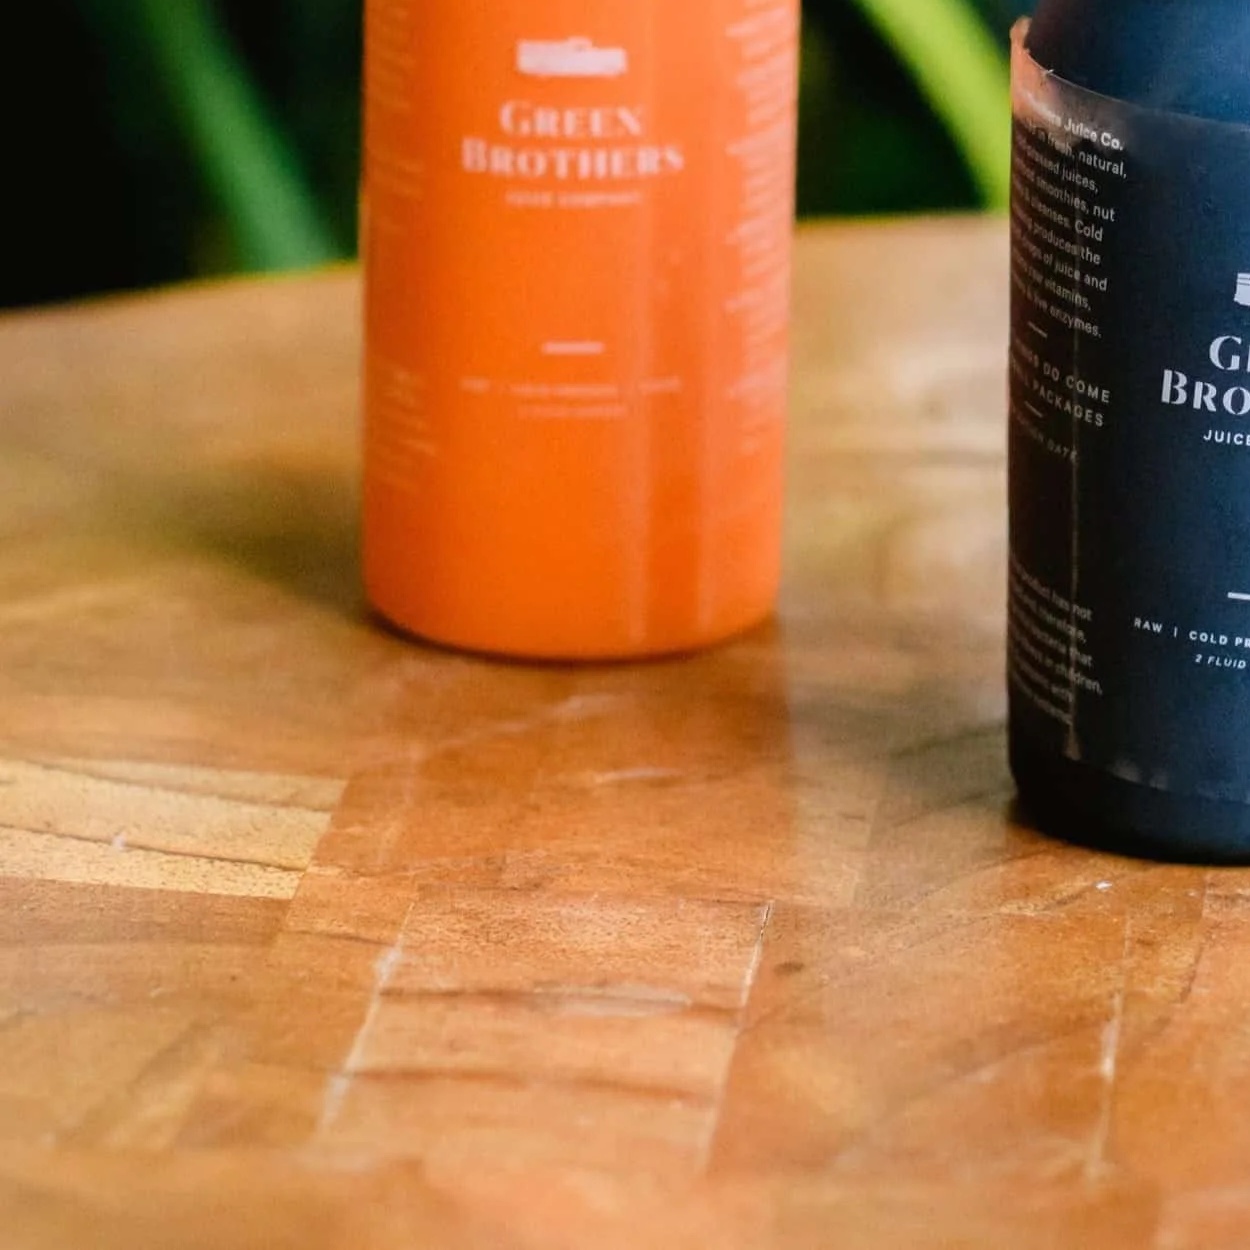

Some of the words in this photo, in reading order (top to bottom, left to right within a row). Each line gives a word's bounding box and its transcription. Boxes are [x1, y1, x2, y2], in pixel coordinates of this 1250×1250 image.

[1063, 117, 1098, 143] Juice
[1100, 131, 1124, 151] Co.
[461, 136, 686, 181] BROTHERS
[1078, 150, 1128, 180] natural,
[1060, 167, 1100, 194] juices,
[1092, 204, 1117, 223] nut
[1074, 218, 1104, 243] Cold
[1080, 244, 1102, 266] the
[1054, 258, 1081, 282] juice
[1083, 271, 1108, 292] and
[1049, 303, 1103, 339] enzymes.
[1043, 360, 1061, 382] DO
[1065, 374, 1111, 404] COME
[1032, 378, 1105, 428] PACKAGES
[1133, 617, 1164, 634] RAW
[1188, 630, 1229, 647] COLD
[1194, 653, 1203, 664] 2
[1207, 656, 1247, 670] FLUID
